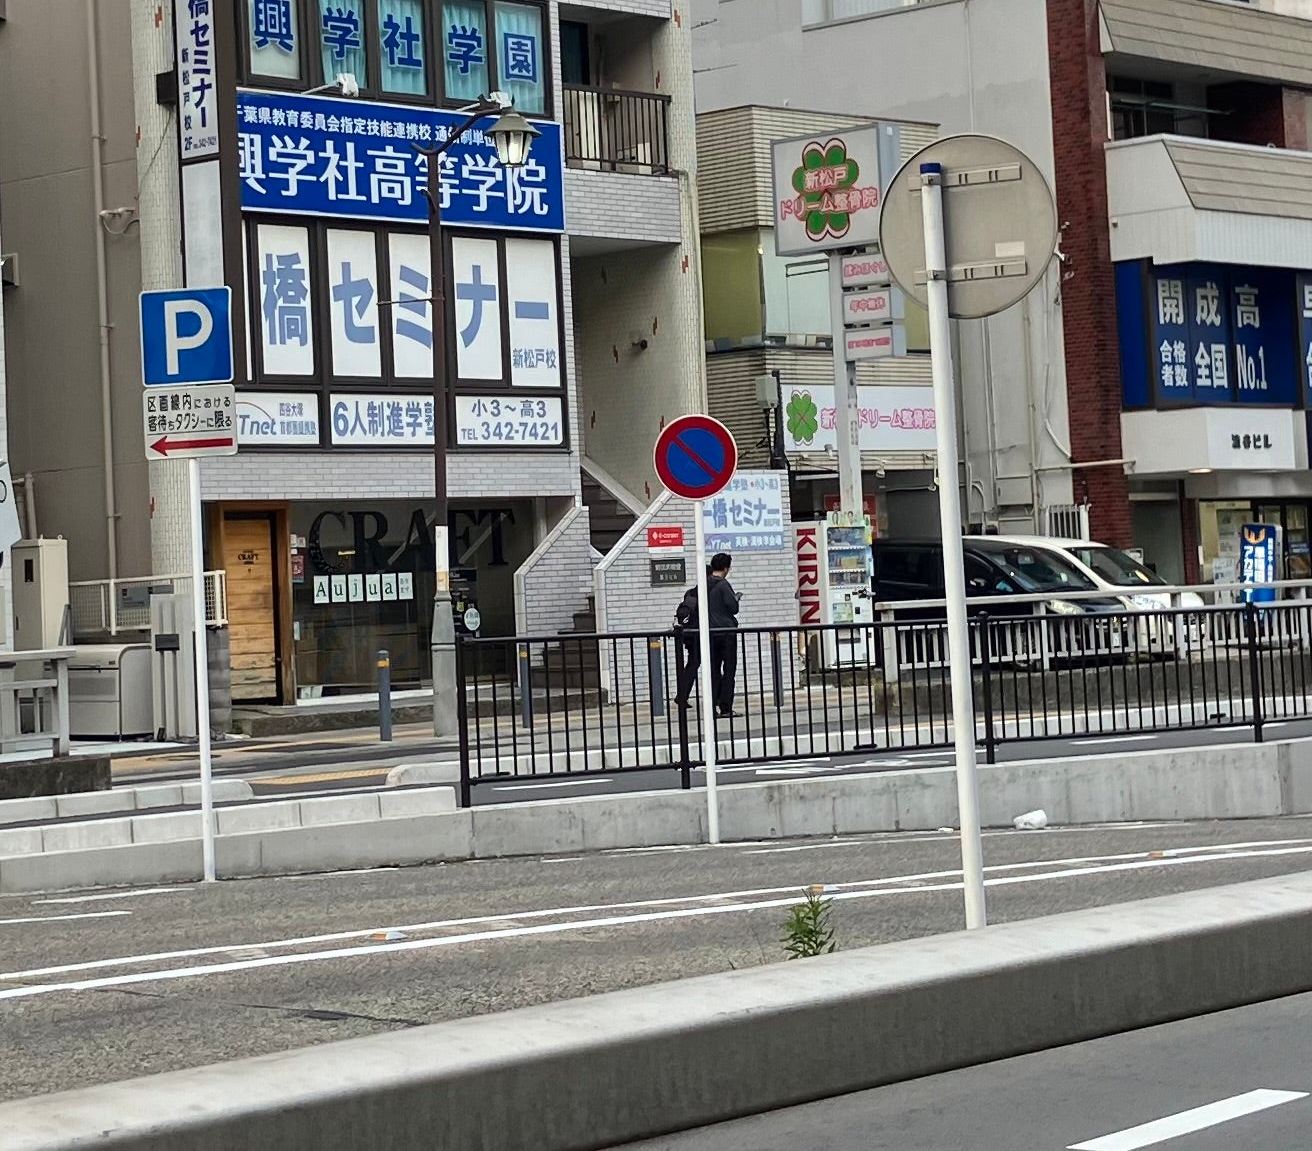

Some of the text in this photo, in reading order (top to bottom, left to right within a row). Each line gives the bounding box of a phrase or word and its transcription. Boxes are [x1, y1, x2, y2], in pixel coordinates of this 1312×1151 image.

[164, 299, 214, 376] P
[236, 414, 278, 436] Tnet
[796, 527, 821, 625] KIRIN
